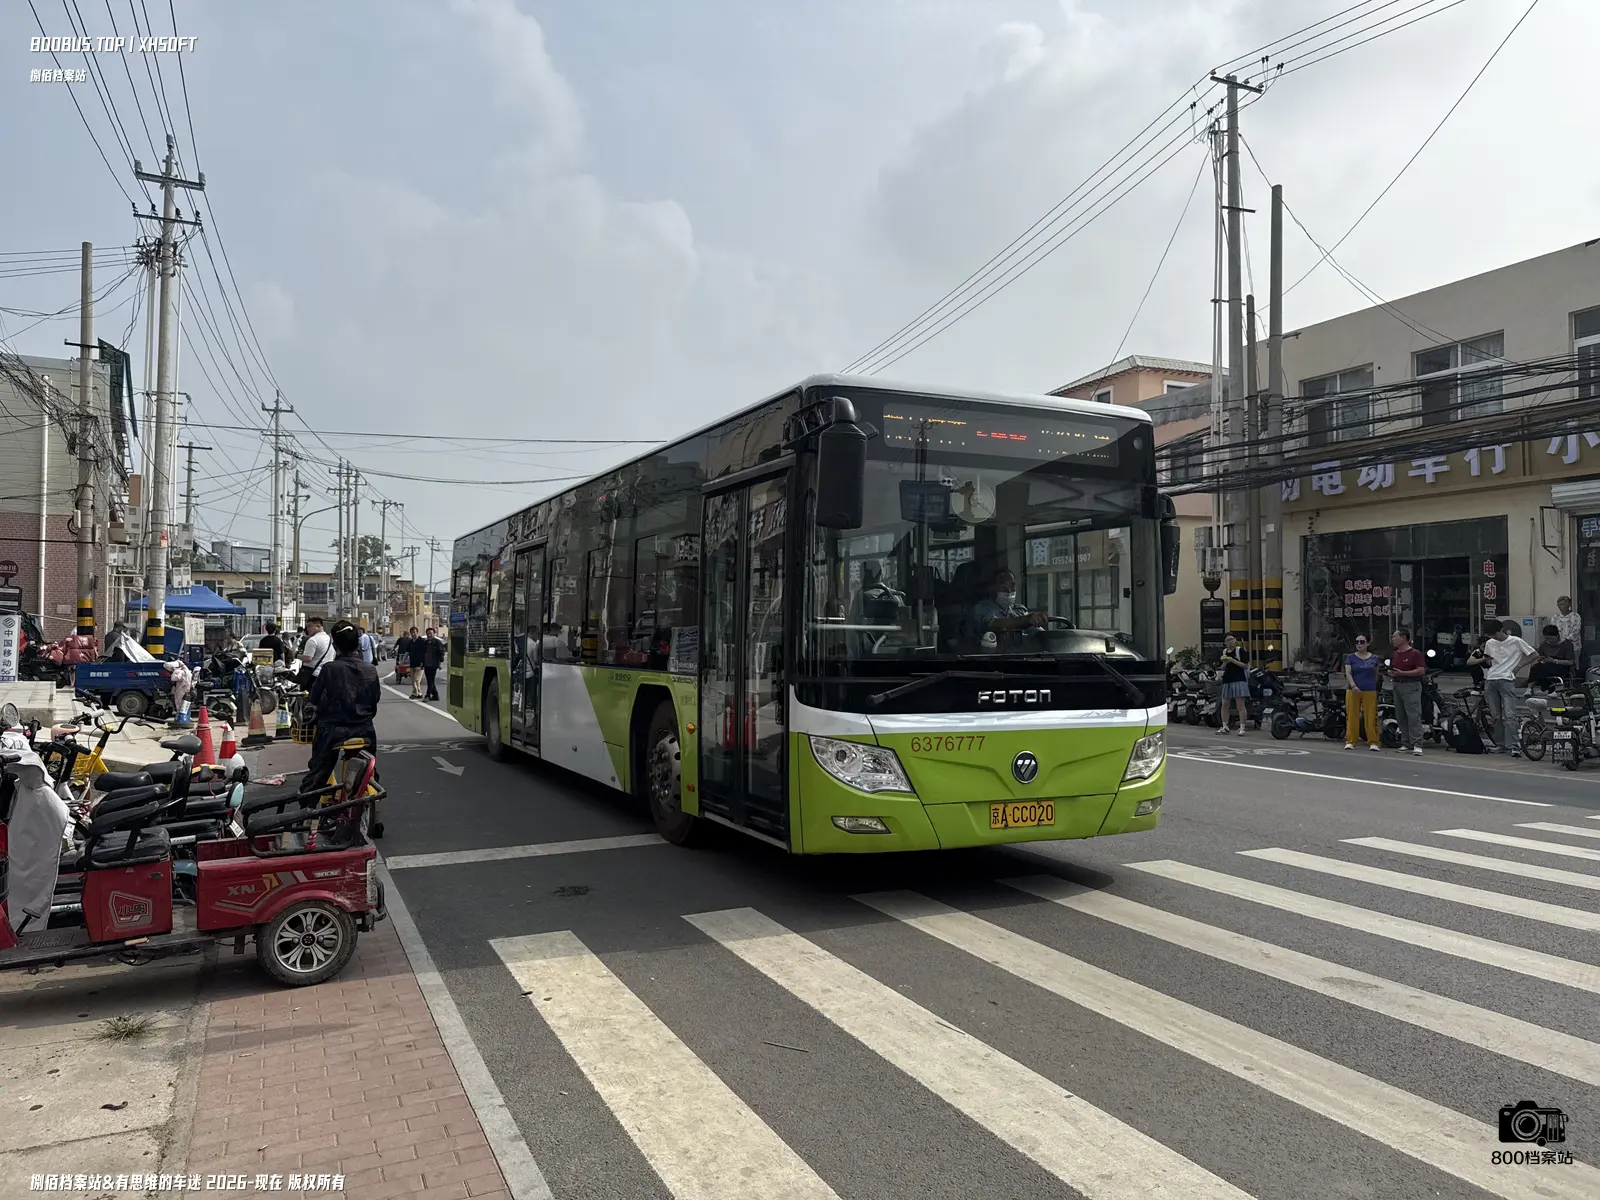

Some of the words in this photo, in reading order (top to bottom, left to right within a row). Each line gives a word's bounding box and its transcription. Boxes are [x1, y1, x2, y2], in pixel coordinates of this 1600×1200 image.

[1344, 579, 1373, 591] 电动车
[2, 629, 13, 667] 中国移动
[978, 689, 1052, 704] FOTON
[911, 735, 986, 752] 6376777
